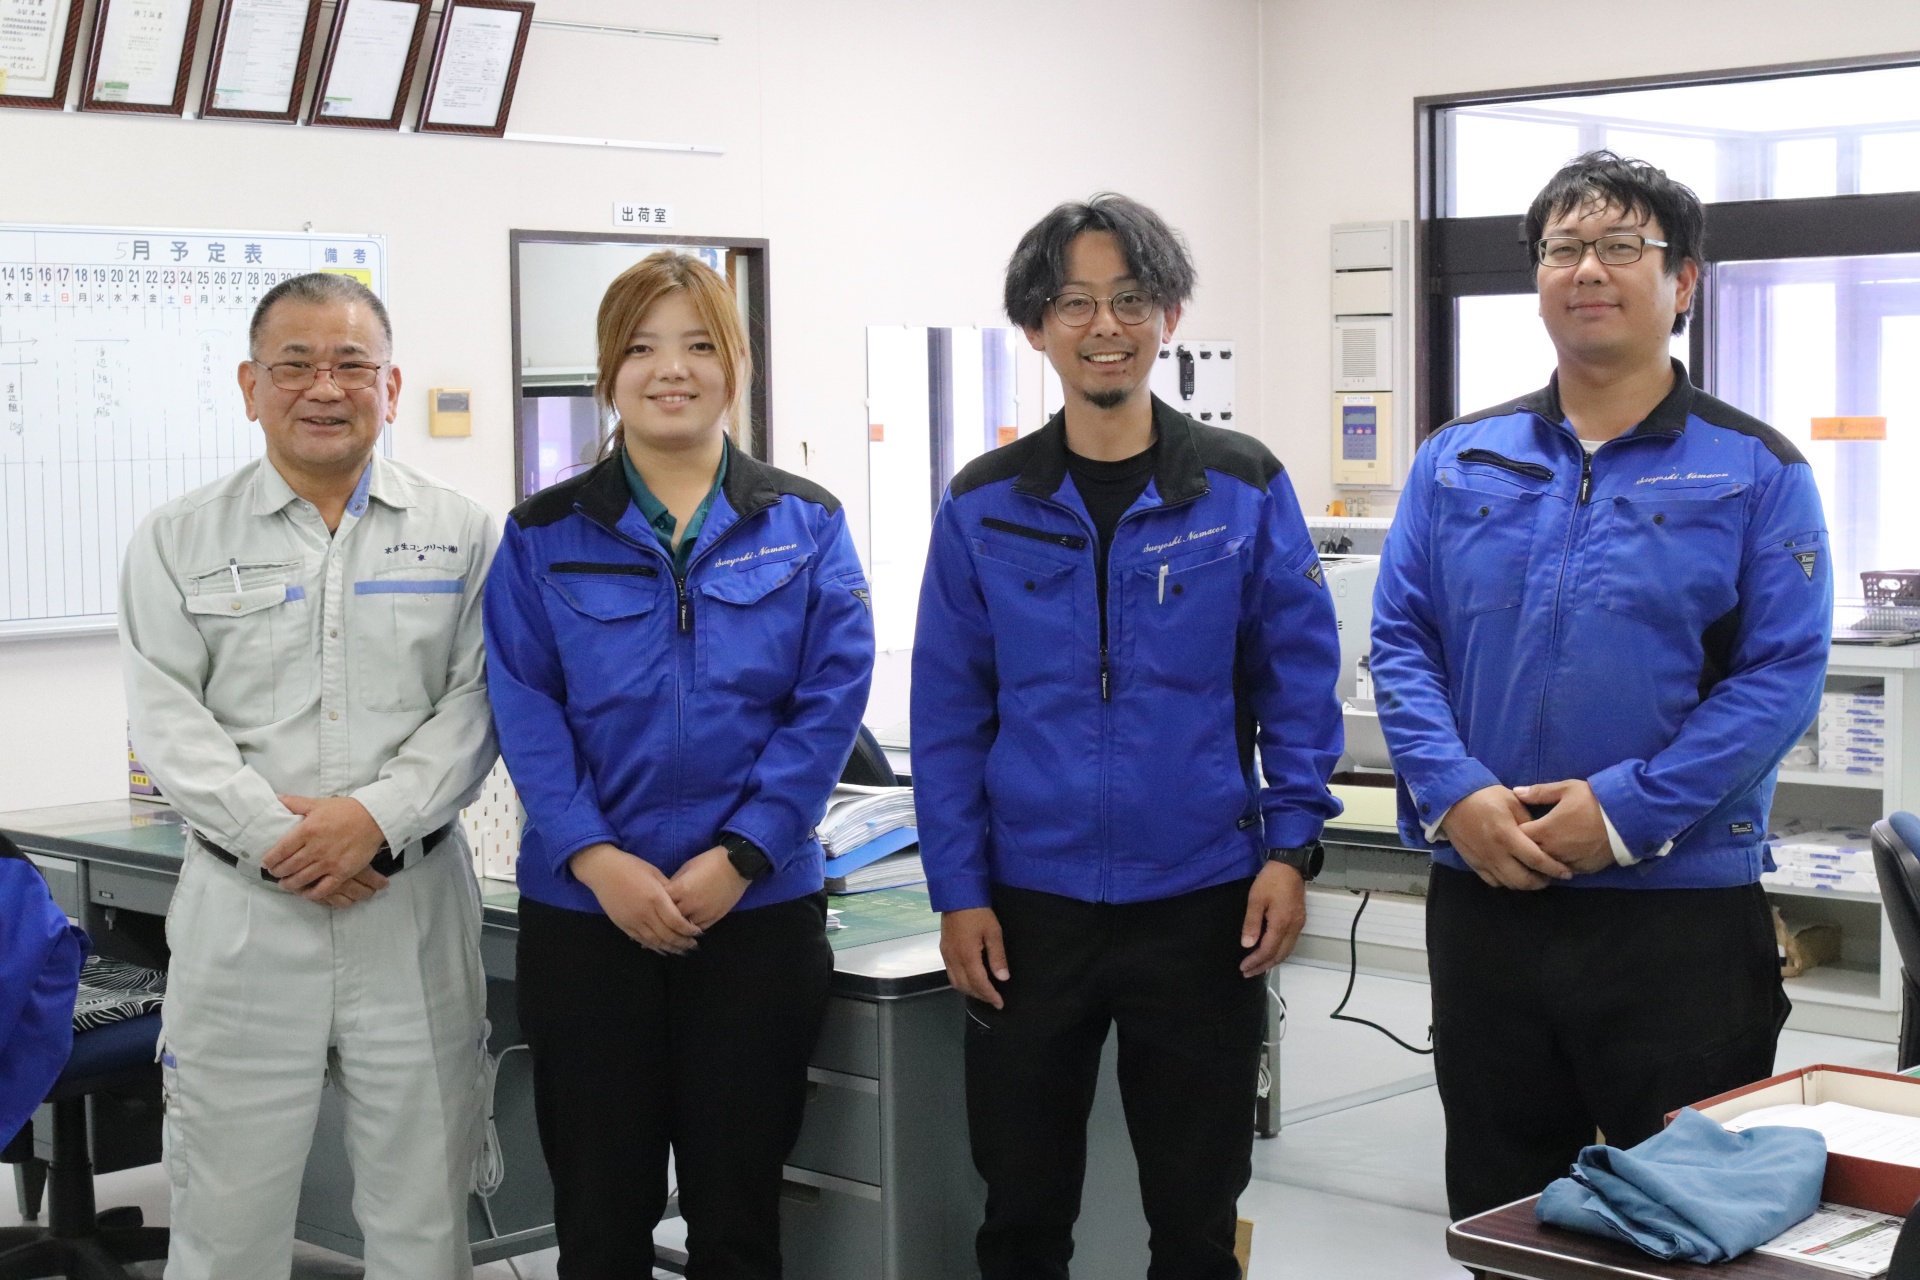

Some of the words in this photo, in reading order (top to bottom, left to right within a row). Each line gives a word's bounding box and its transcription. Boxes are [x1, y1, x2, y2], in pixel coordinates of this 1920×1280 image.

[622, 206, 666, 223] 出荷室
[324, 247, 366, 264] 備考
[2, 266, 15, 282] 14
[20, 266, 33, 282] 15
[38, 268, 52, 282] 16
[56, 268, 69, 282] 17
[74, 268, 88, 282] 18
[93, 268, 106, 283] 19
[110, 269, 124, 284] 20
[128, 269, 140, 284] 21
[146, 270, 158, 284] 22
[163, 270, 176, 284] 23
[180, 271, 193, 284] 24
[198, 271, 210, 285] 25
[214, 272, 226, 285] 26
[231, 272, 242, 285] 27
[248, 272, 260, 286] 28
[264, 272, 276, 286] 29
[5, 292, 14, 302] 木
[24, 292, 32, 302] 金
[42, 293, 50, 302] 土
[61, 293, 69, 302] 日
[78, 293, 87, 302] 月
[96, 294, 104, 302] 火
[114, 294, 122, 302] 水
[131, 294, 140, 302] 木
[149, 294, 158, 303] 金
[167, 295, 175, 304] 土
[184, 296, 191, 304] 日
[200, 295, 208, 304] 月
[218, 296, 226, 304] 火
[234, 296, 242, 304] 水
[1183, 524, 1227, 542] Namacon
[754, 543, 797, 558] Namacon
